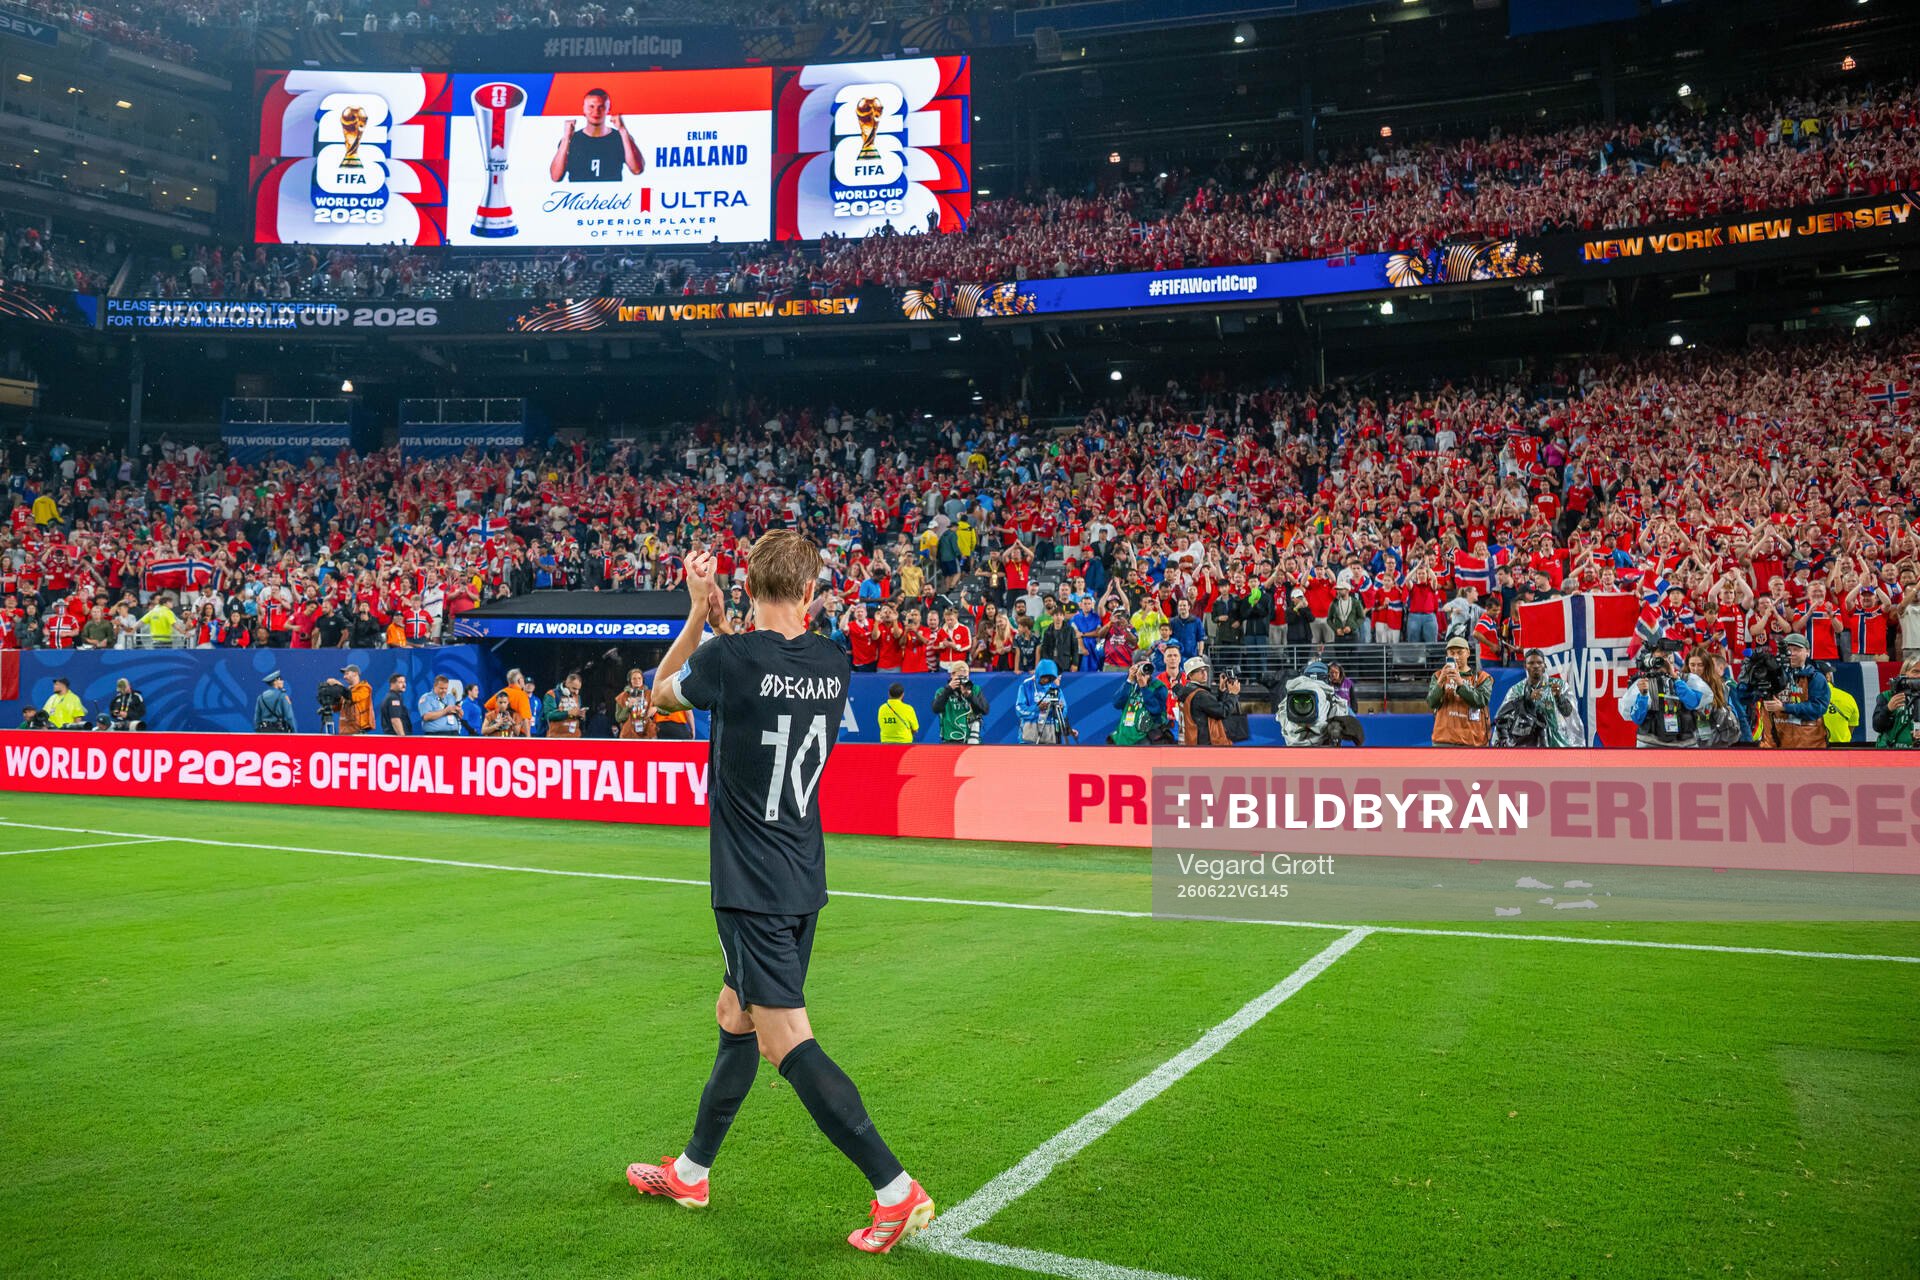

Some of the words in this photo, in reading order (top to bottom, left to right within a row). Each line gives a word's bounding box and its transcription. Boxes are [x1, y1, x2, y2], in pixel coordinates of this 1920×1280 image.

[544, 35, 682, 58] #FIFAWorldCup
[687, 131, 718, 141] ERLING
[656, 144, 748, 167] HAALAND
[854, 165, 885, 176] FIFA
[336, 173, 367, 185] FIFA
[542, 190, 633, 212] Michelob
[661, 190, 750, 209] ULTRA
[834, 189, 878, 200] WORLD
[879, 187, 904, 198] CUP
[315, 196, 359, 207] WORLD
[360, 197, 385, 208] CUP
[834, 199, 904, 217] 2026
[314, 208, 384, 224] 2026
[577, 218, 652, 226] SUPERIOR
[660, 216, 717, 224] PLAYER
[617, 229, 644, 237] THE
[652, 228, 702, 236] MATCH
[1584, 237, 1644, 260] NEW
[1649, 227, 1723, 254] YORK
[1728, 218, 1792, 244] NEW
[1797, 203, 1912, 236] JERSEY
[1149, 275, 1258, 296] #FIFAWorldCup
[108, 300, 156, 311] PLEASE
[272, 302, 338, 314] TOGETHER
[618, 305, 666, 322] NEW
[669, 303, 726, 321] YORK
[728, 301, 775, 319] NEW
[778, 297, 860, 317] JERSEY
[107, 316, 133, 326] FOR
[300, 306, 350, 326] CUP
[353, 307, 438, 327] 2026
[246, 437, 286, 446] WORLD
[287, 437, 310, 446] CUP
[400, 437, 421, 446] FIFA
[423, 437, 462, 446] WORLD
[486, 437, 524, 446] 2026
[517, 622, 544, 634] FIFA
[546, 623, 593, 635] WORLD
[595, 623, 622, 635] CUP
[622, 624, 670, 635] 2026
[759, 673, 842, 700] ØDEGAARD
[5, 746, 107, 780] WORLD
[112, 748, 173, 783] CUP
[178, 749, 292, 787] 2026
[308, 751, 454, 795] OFFICIAL
[461, 756, 710, 806] HOSPITALITY
[761, 714, 827, 822] 10
[1068, 773, 1383, 832] PREMIUM
[1402, 776, 1920, 848] EXPERIENCE
